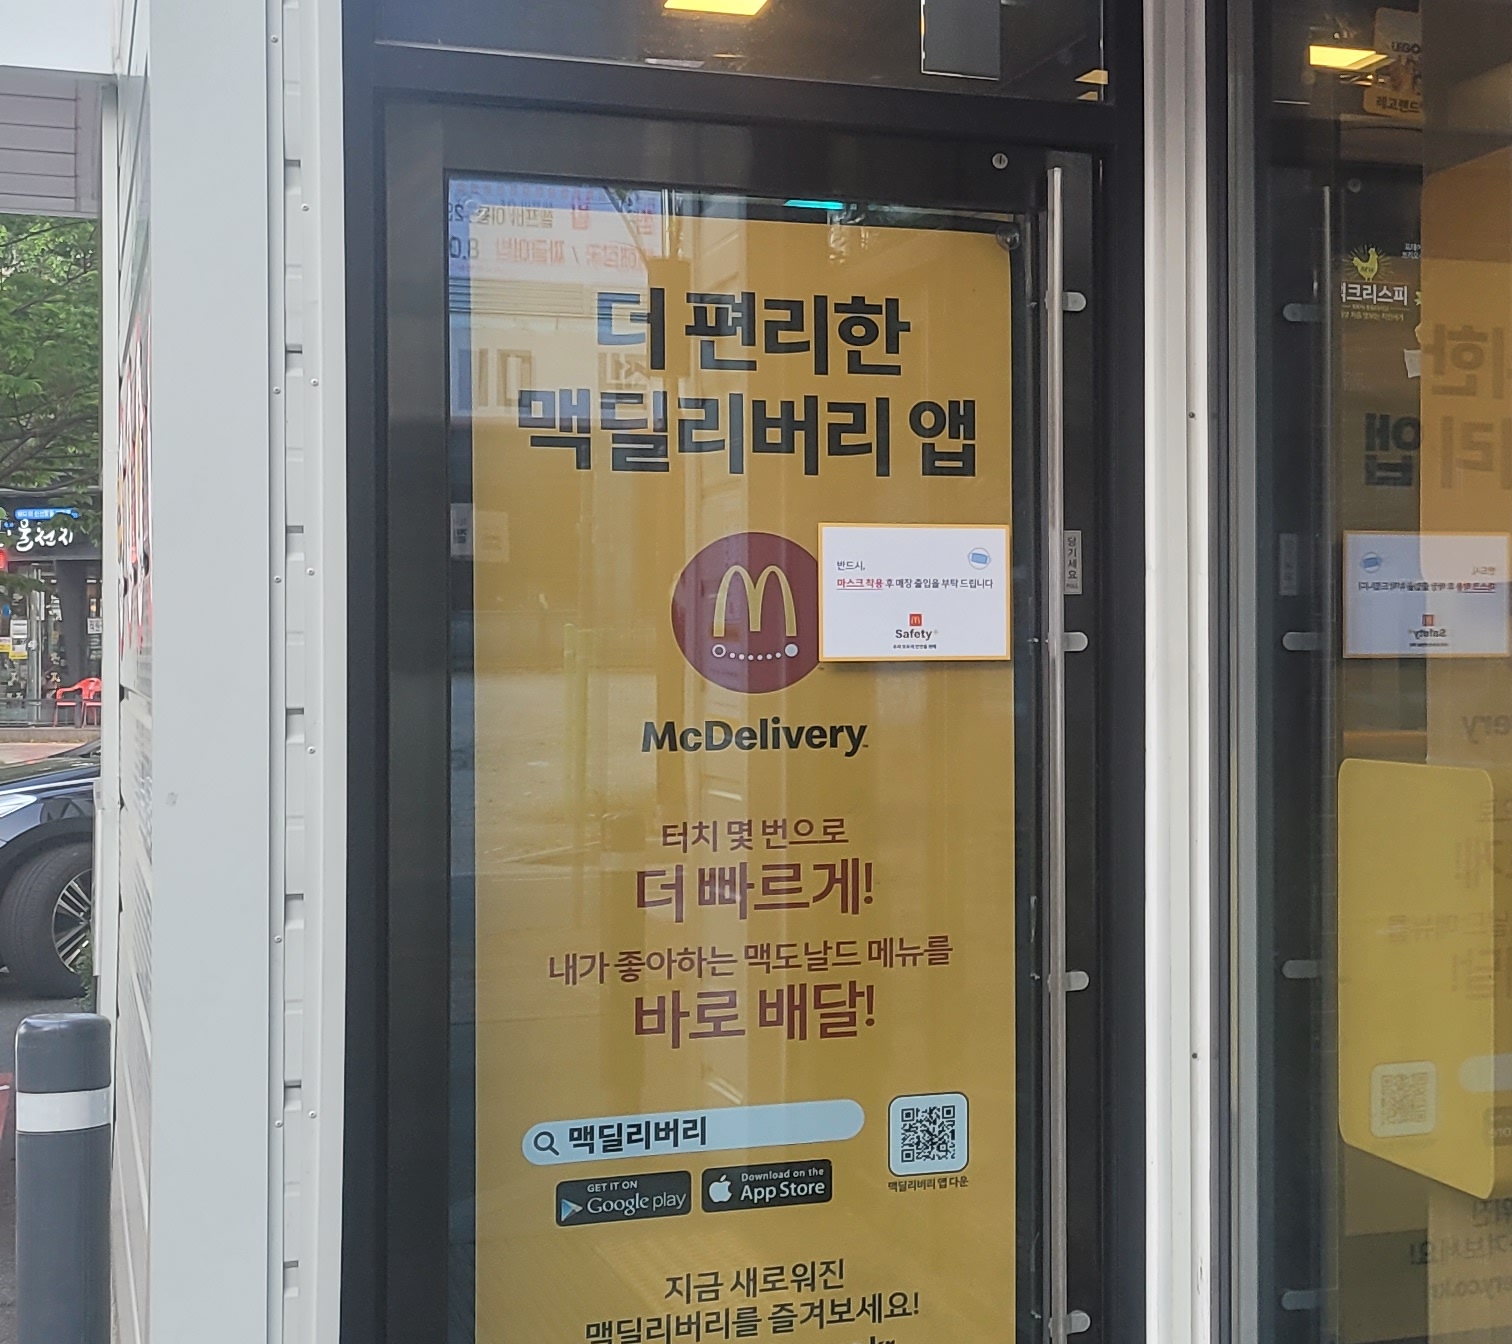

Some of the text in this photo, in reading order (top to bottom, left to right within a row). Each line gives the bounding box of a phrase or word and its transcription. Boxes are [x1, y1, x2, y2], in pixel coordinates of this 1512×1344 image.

[595, 286, 667, 372] 더
[684, 291, 912, 377] 편리한
[517, 388, 978, 477] 맥딜리버리 앱
[1067, 536, 1078, 580] 당기세요
[836, 578, 865, 589] 마스크
[885, 578, 894, 589] 후
[895, 578, 912, 589] 매장
[941, 578, 959, 589] 부탁
[960, 578, 994, 589] 드립니다
[641, 715, 867, 758] McDelivery
[660, 817, 850, 855] 터치 몇 번으로
[635, 856, 874, 925] 더 빠르게!
[547, 933, 954, 987] 내가 좋아하는 맥도날드 메뉴를
[633, 979, 877, 1051] 바로 배달!
[567, 1115, 709, 1155] 맥딜리버리
[586, 1179, 638, 1194] GET IT ON
[739, 1179, 826, 1204] App Store
[741, 1166, 825, 1183] Download on the
[937, 1177, 948, 1189] 앱
[948, 1175, 969, 1188] 다운
[586, 1189, 688, 1217] Google play
[663, 1257, 845, 1305] 지금 새로워진
[767, 1290, 920, 1335] 즐겨보세요!
